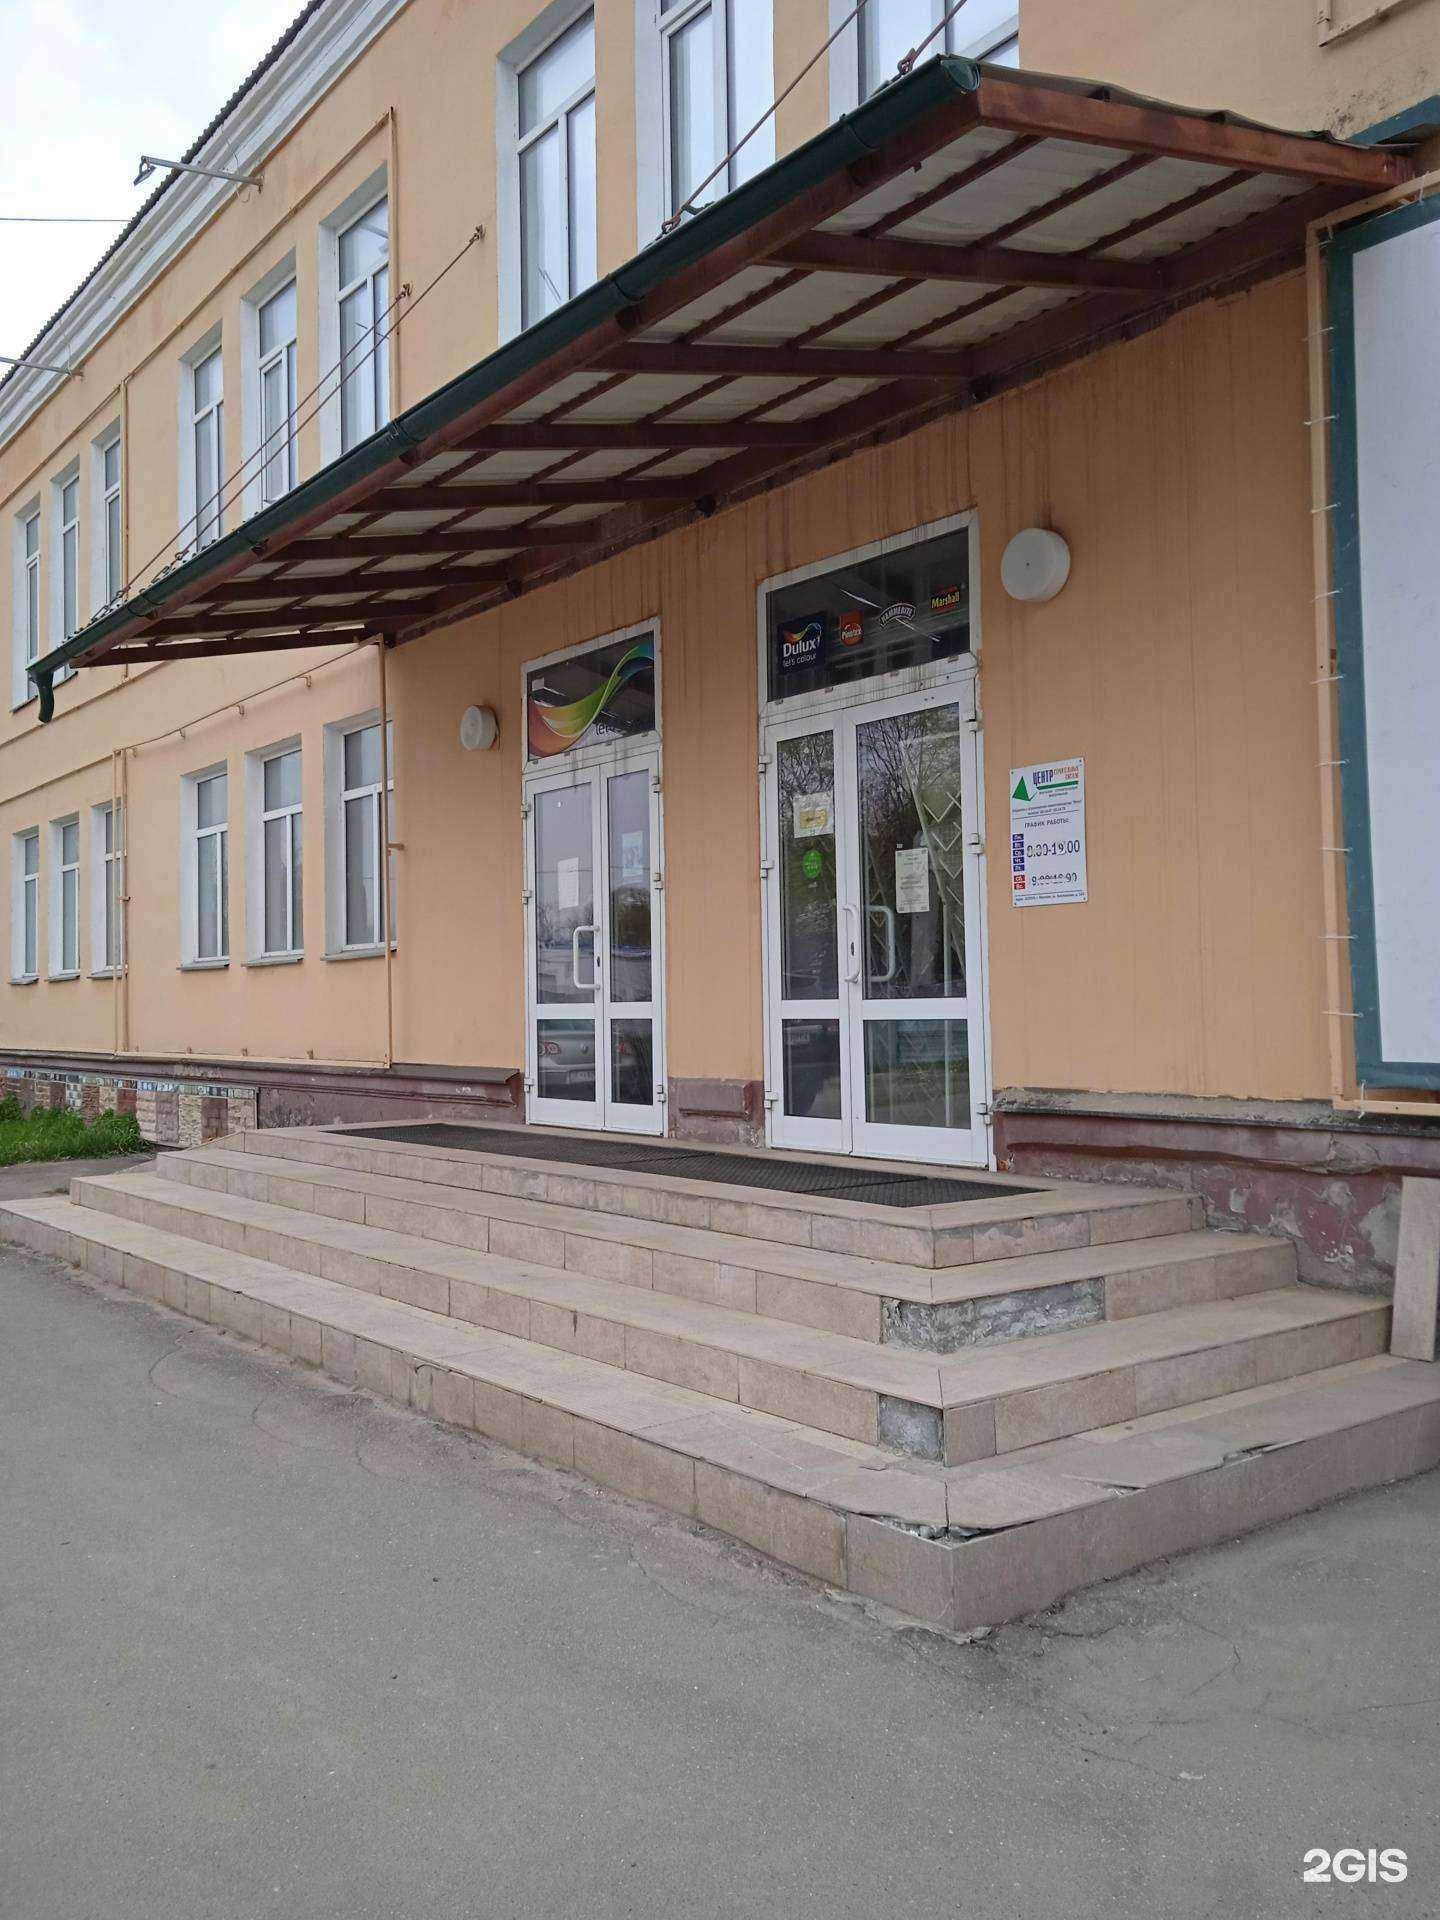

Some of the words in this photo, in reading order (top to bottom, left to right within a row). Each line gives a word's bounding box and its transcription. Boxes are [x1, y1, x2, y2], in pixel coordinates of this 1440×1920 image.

[931, 591, 960, 608] Marshall
[783, 637, 817, 658] Dulux
[1032, 768, 1054, 787] ЦЕНТР
[1024, 820, 1045, 829] ГРАФИК
